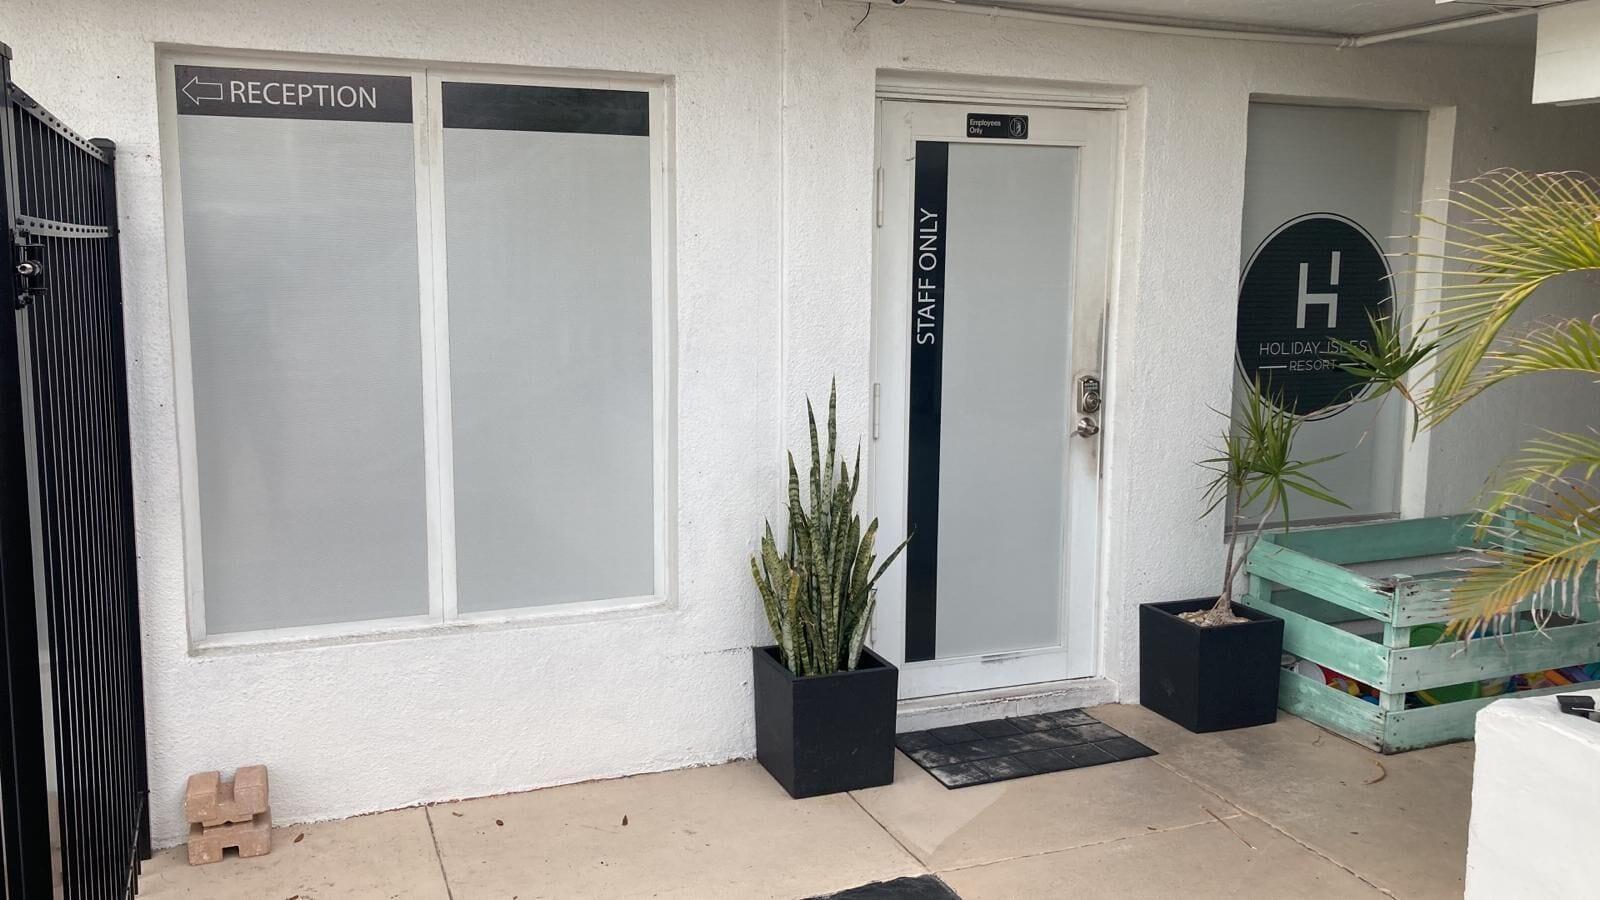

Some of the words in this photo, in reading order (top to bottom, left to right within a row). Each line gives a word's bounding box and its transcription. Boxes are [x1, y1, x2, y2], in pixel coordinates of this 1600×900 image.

[229, 80, 378, 109] RECEPTION
[969, 119, 1001, 127] Employees
[969, 126, 983, 134] Only
[918, 207, 938, 271] ONLY
[916, 277, 936, 345] STAFF
[1259, 342, 1320, 356] HOLIDAY
[1289, 359, 1336, 371] RESORT
